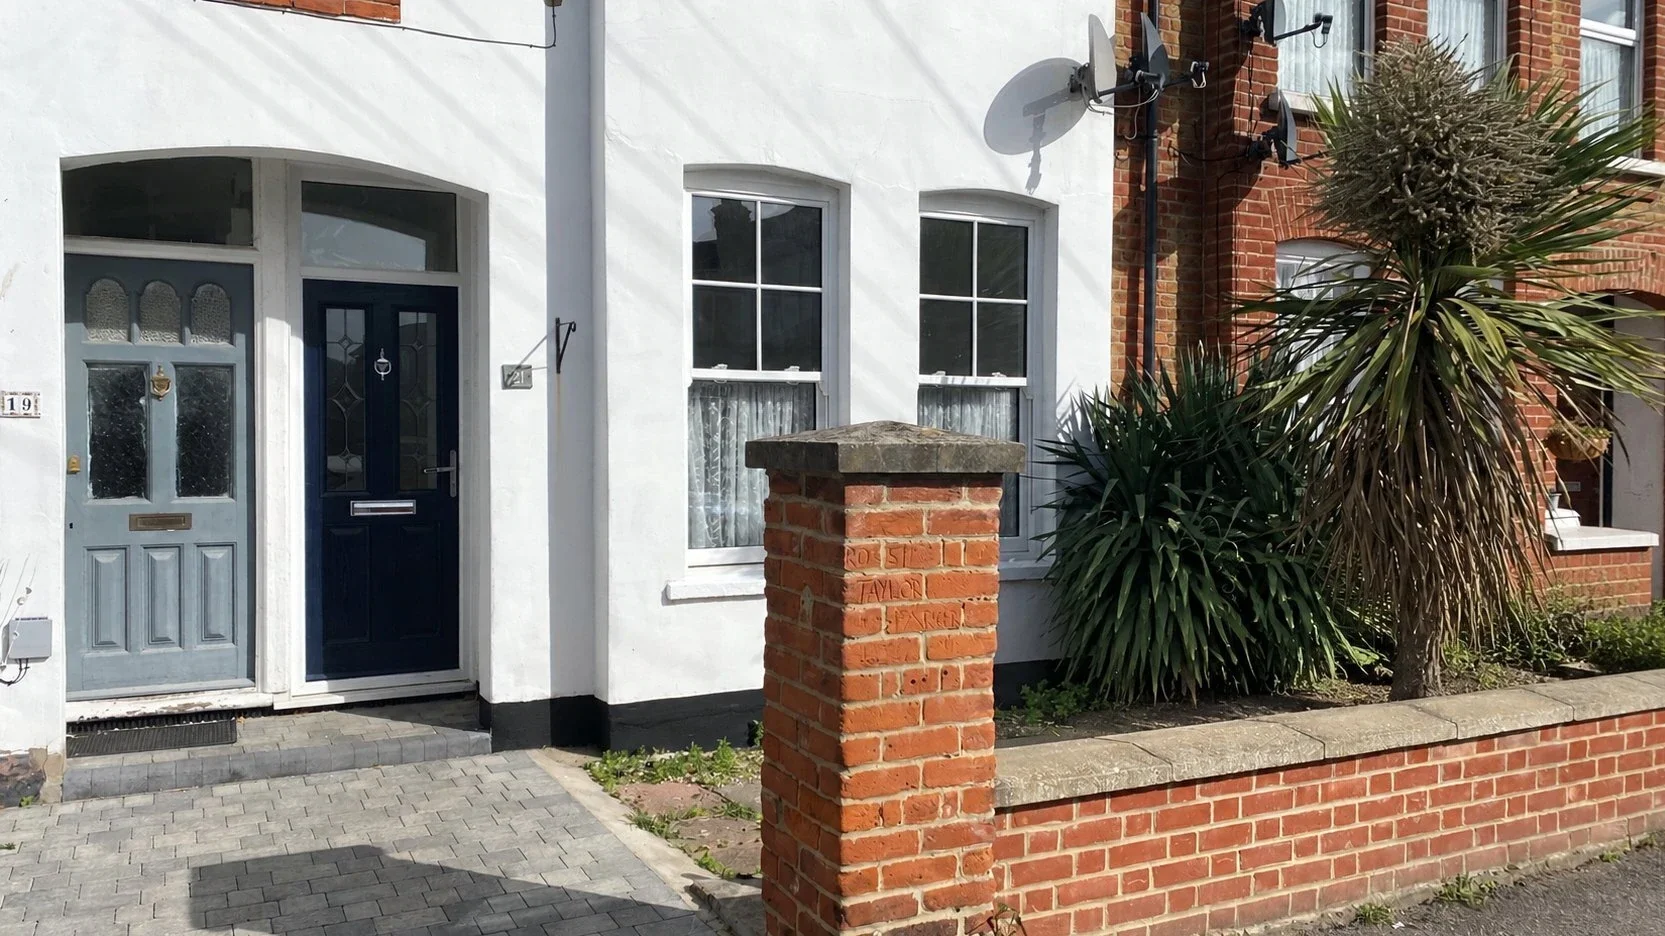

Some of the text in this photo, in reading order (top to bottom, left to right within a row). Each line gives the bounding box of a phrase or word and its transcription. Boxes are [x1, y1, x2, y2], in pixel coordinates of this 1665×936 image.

[512, 370, 525, 384] 21
[7, 397, 32, 411] 19
[857, 577, 923, 604] TAYLOR
